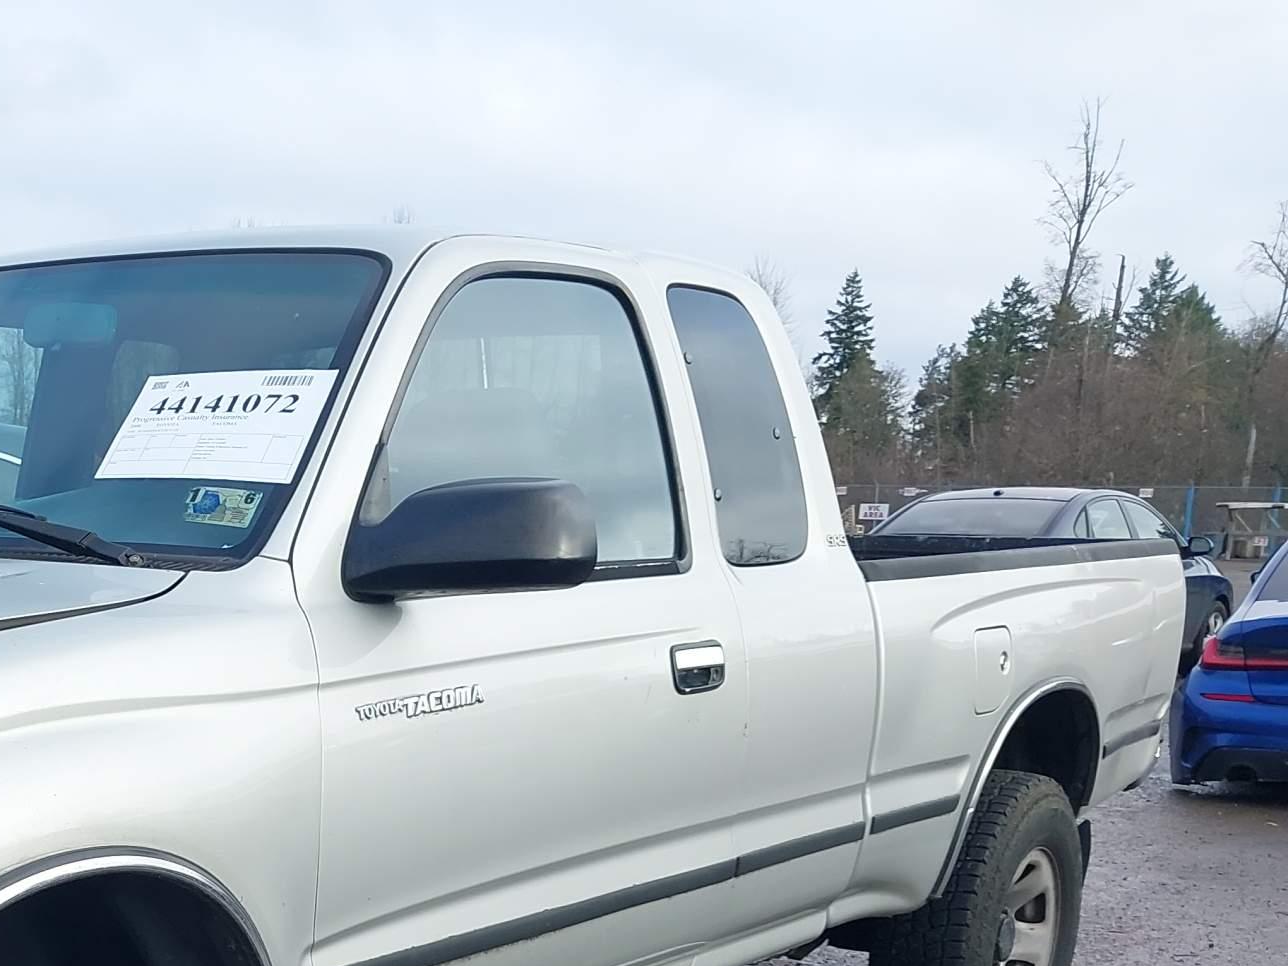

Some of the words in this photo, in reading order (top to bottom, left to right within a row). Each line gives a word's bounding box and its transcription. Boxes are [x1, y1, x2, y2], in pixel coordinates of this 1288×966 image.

[149, 394, 300, 415] 44141072
[212, 413, 249, 421] Insurance
[244, 492, 256, 505] 6
[355, 699, 404, 721] TOYOTA
[403, 684, 485, 719] TACOMA
